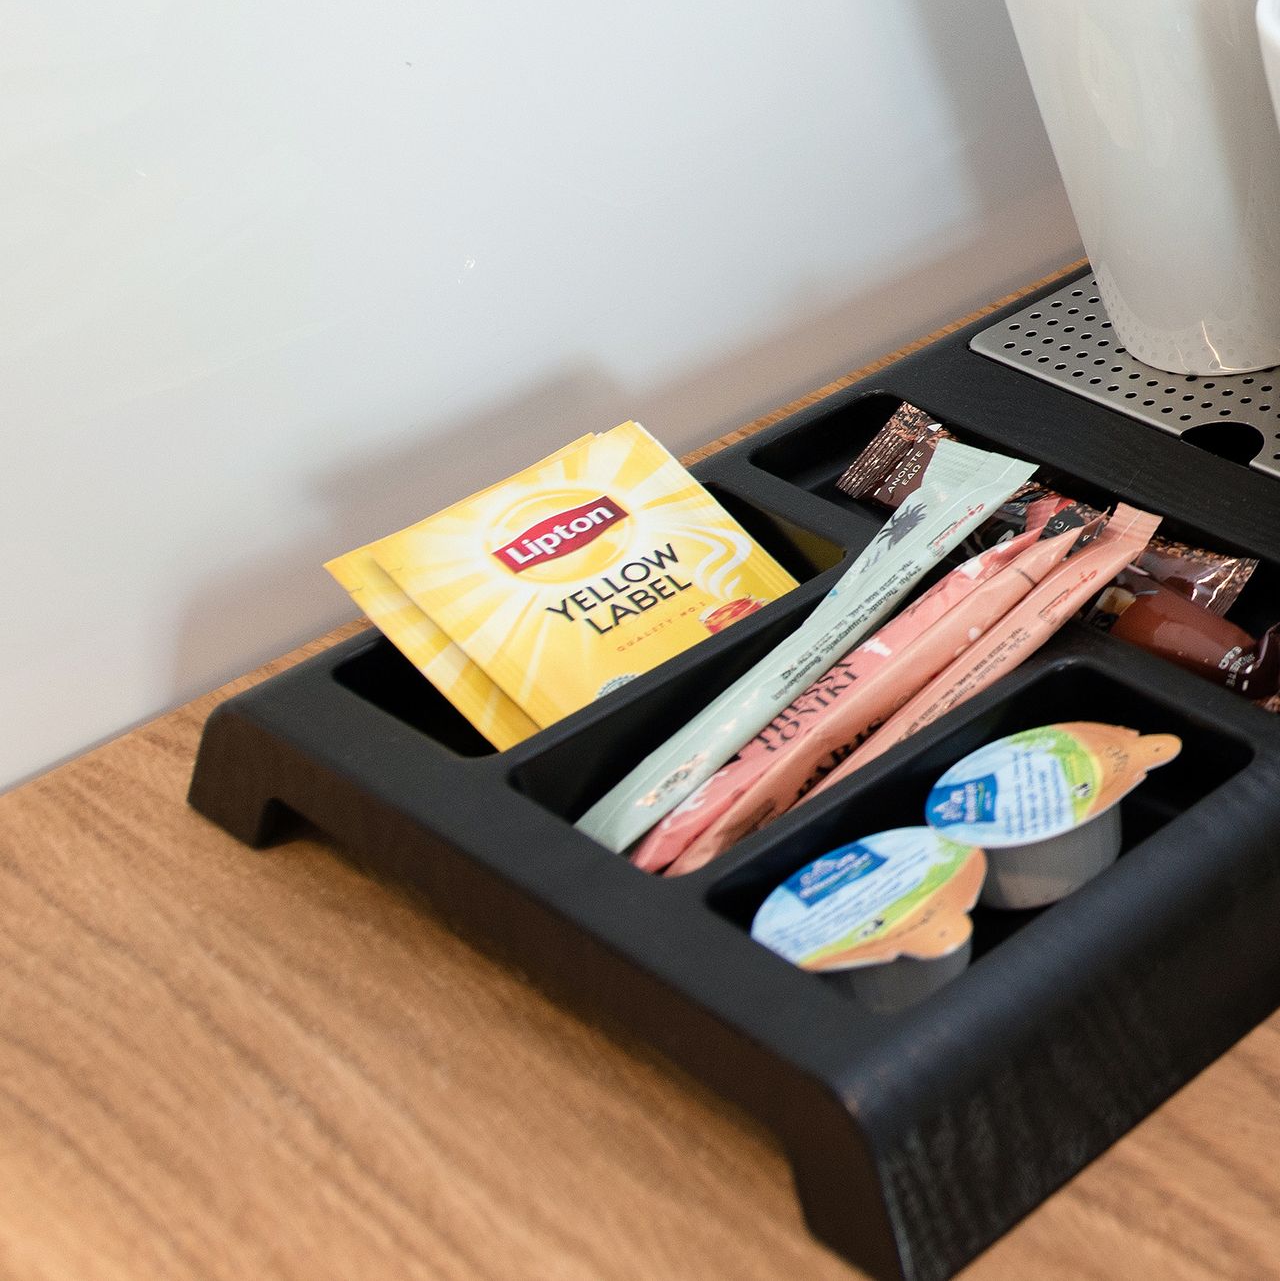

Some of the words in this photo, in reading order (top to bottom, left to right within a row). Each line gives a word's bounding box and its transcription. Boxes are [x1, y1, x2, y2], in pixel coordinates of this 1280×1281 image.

[505, 505, 615, 565] Lipton
[545, 543, 680, 622] YELLOW
[584, 574, 692, 635] LABEL
[616, 618, 673, 652] QUALITY
